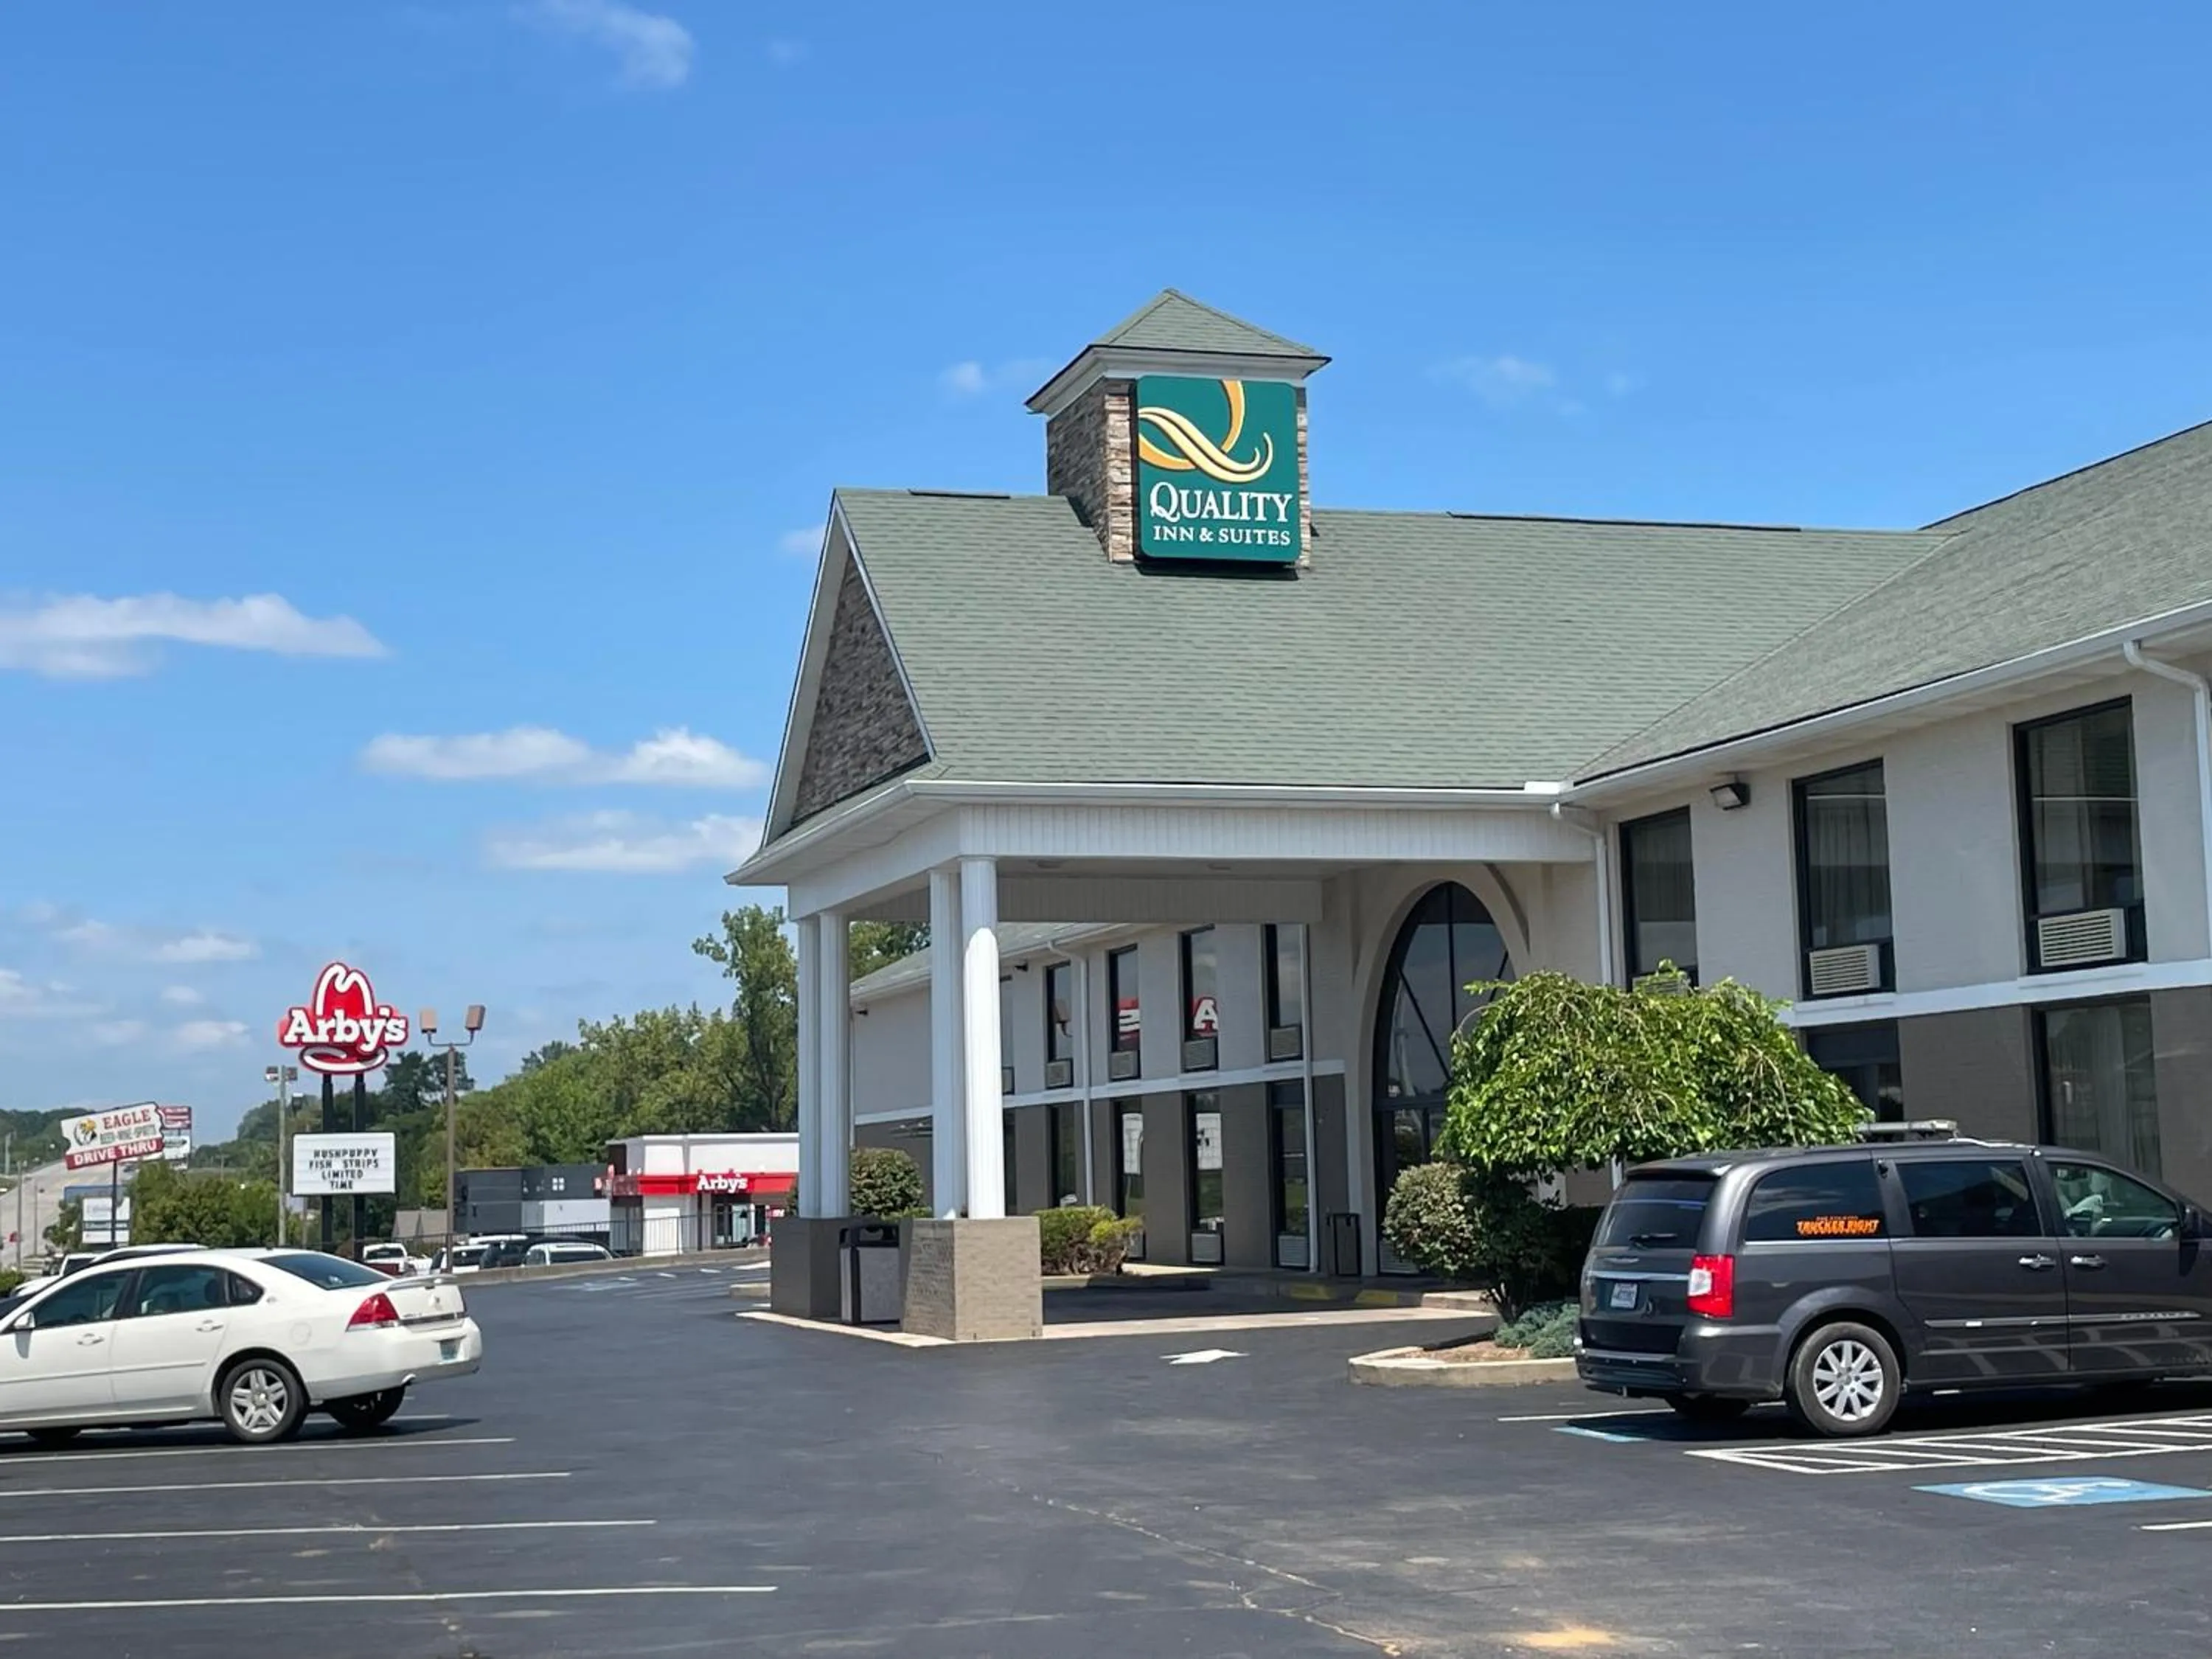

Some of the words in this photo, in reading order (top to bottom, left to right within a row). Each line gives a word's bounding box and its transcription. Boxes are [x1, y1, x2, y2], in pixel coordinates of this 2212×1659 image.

[1150, 481, 1293, 522] QUALITY
[1153, 526, 1194, 540] INN
[1199, 527, 1214, 541] &
[1218, 528, 1290, 545] SUITES
[283, 1007, 407, 1052] Arby's
[102, 1109, 151, 1130] EAGLE
[74, 1146, 116, 1166] DRIVE
[118, 1139, 157, 1157] THRU
[309, 1160, 333, 1169] FISH
[343, 1158, 378, 1169] STRIPS
[321, 1169, 364, 1180] LIMITED
[330, 1180, 353, 1189] TIME
[697, 1172, 748, 1194] Arby's
